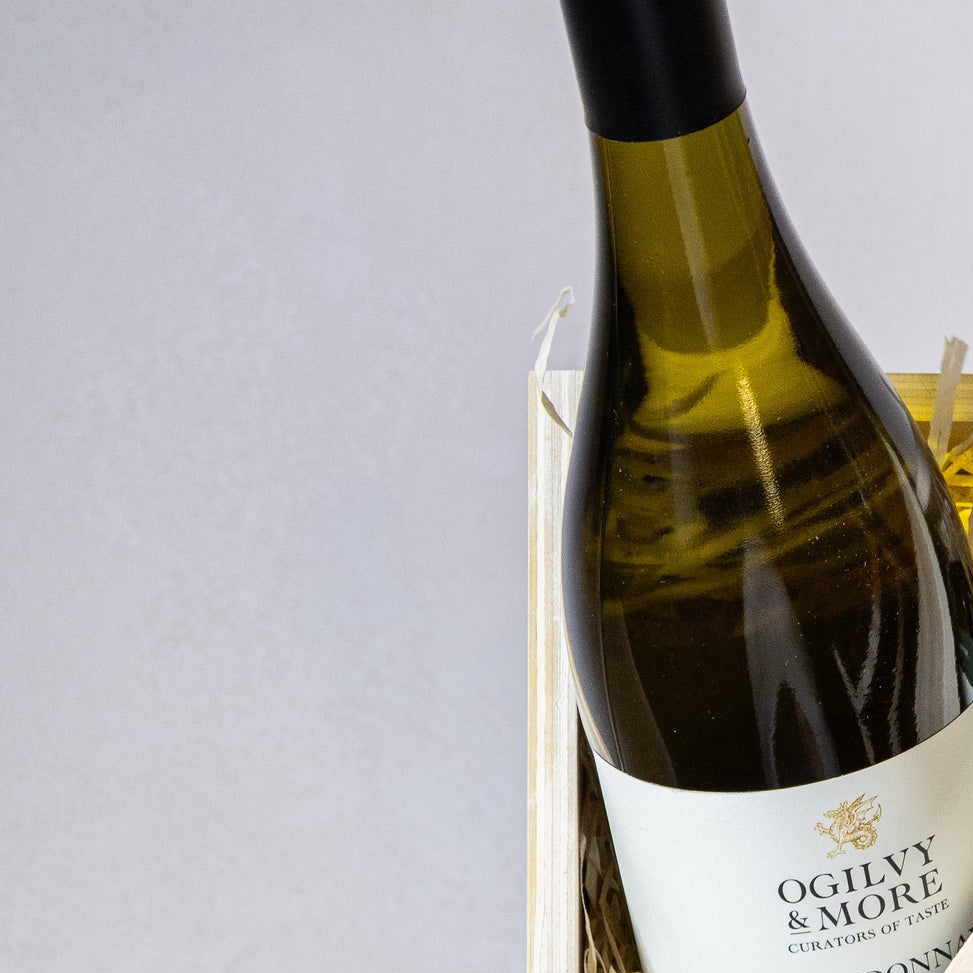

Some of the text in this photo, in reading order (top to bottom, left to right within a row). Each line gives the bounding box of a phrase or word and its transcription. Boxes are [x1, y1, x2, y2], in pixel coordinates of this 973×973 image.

[778, 834, 936, 904] OGILVY
[788, 868, 943, 931] & MORE
[788, 898, 950, 954] CURATORS OF TASTE
